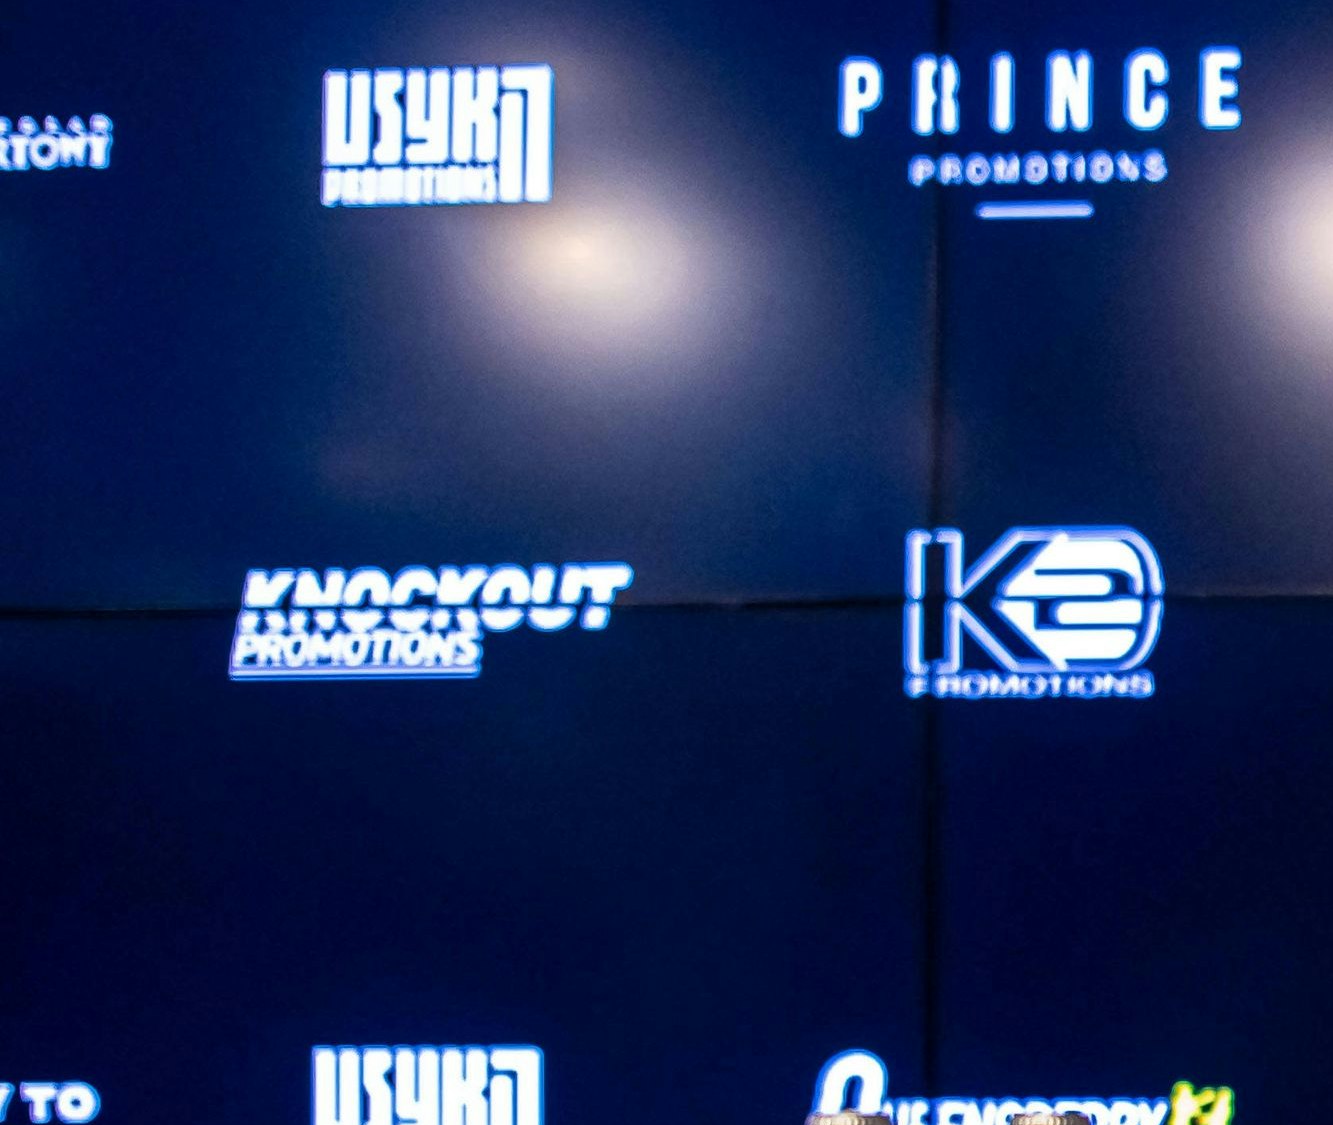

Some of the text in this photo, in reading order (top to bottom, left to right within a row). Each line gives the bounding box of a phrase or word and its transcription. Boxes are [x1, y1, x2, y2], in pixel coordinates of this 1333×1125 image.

[838, 45, 1242, 138] PRINCE
[907, 148, 1168, 187] PROMOTIONS
[241, 561, 636, 633] KNOCKOUT
[231, 630, 485, 669] PROMOTIONS
[19, 1081, 102, 1125] TO
